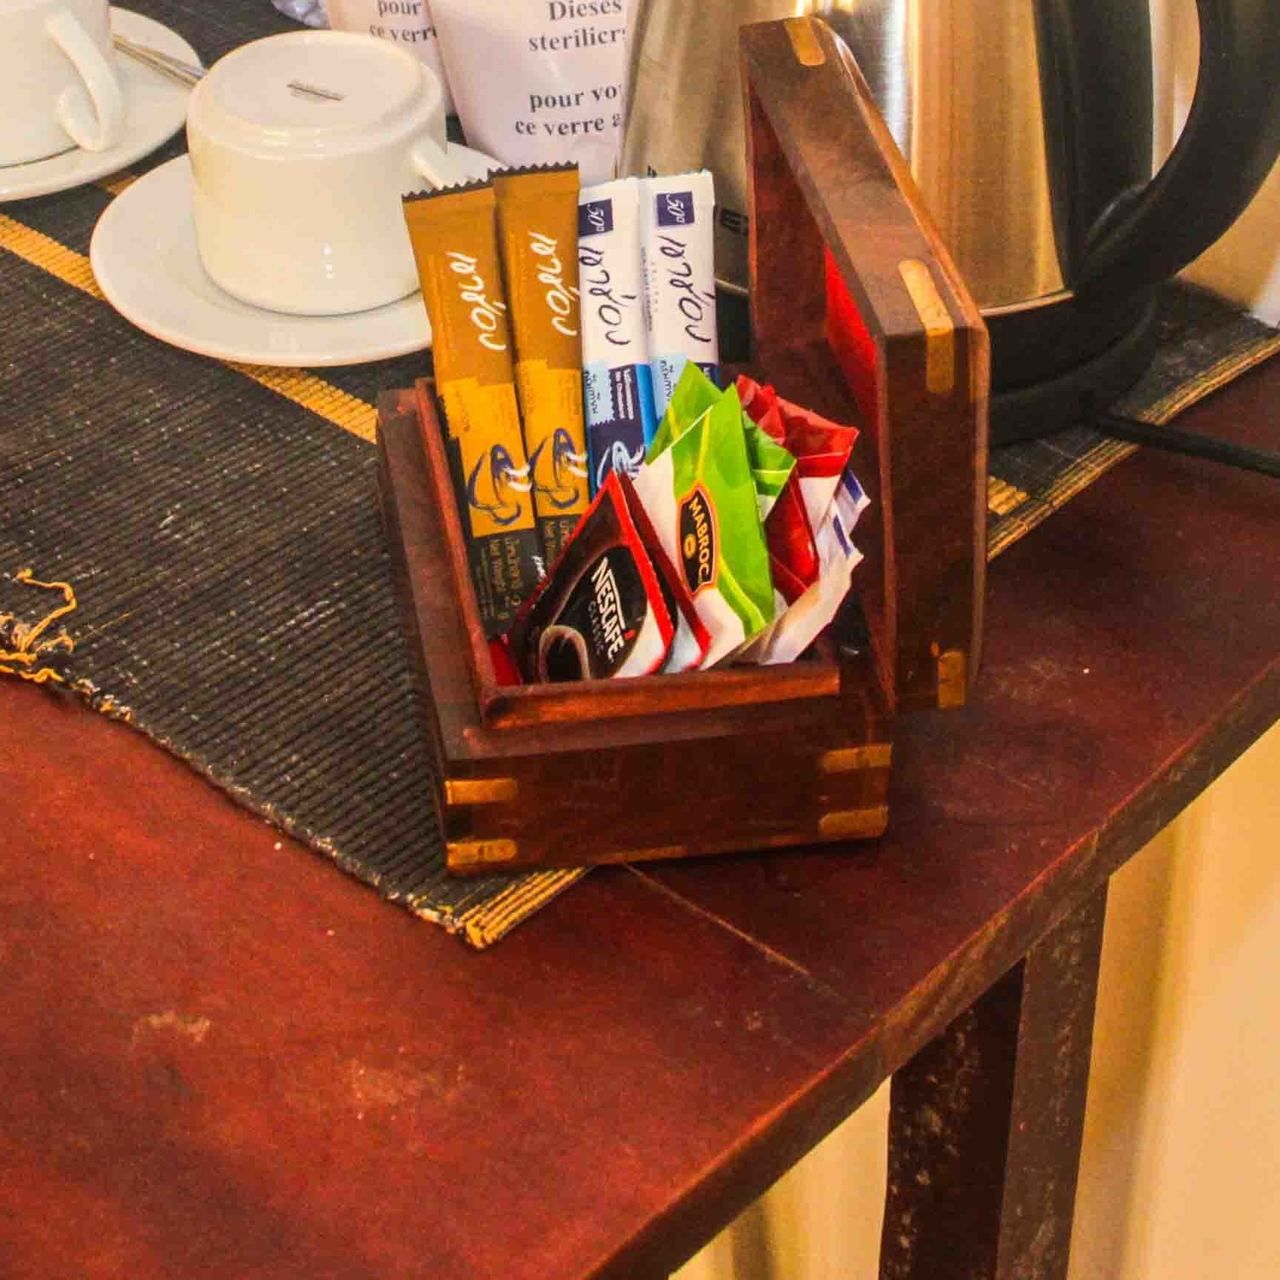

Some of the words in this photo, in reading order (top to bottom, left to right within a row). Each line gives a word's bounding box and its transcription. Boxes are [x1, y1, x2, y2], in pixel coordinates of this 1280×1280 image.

[529, 91, 585, 113] pour
[591, 84, 622, 102] vo
[515, 119, 536, 136] ce
[543, 116, 605, 137] verre
[687, 495, 711, 578] MABROC
